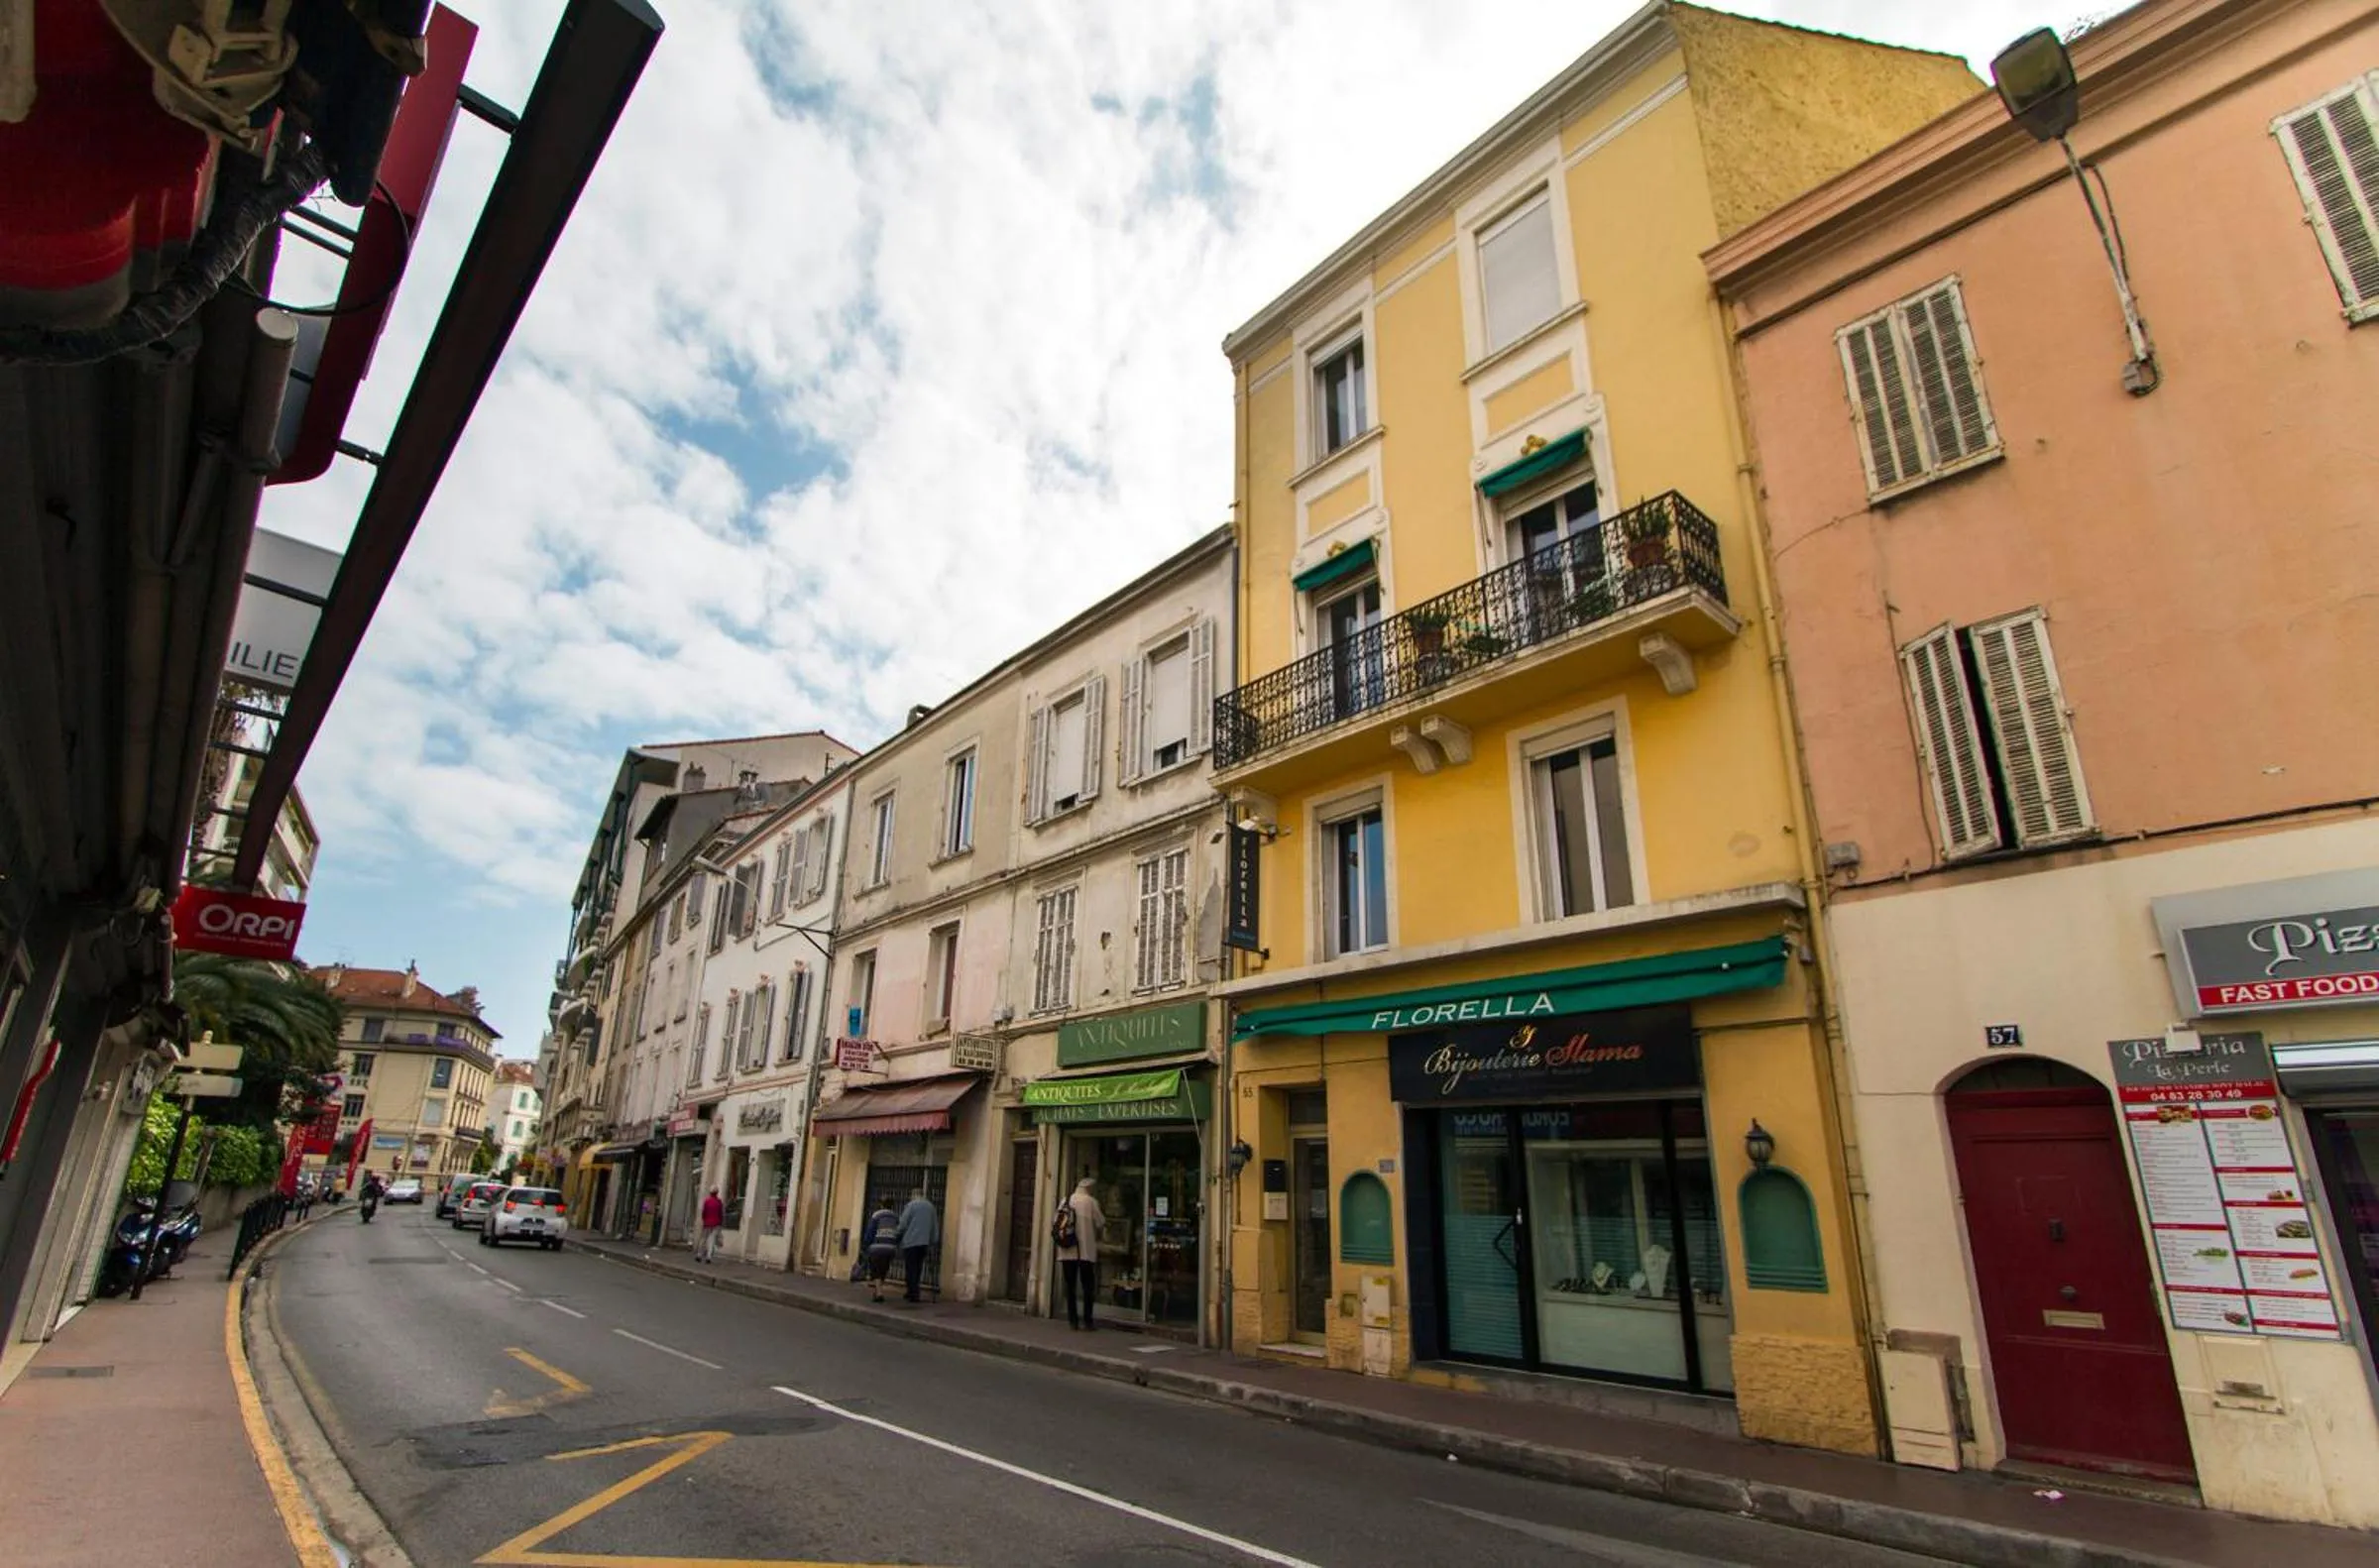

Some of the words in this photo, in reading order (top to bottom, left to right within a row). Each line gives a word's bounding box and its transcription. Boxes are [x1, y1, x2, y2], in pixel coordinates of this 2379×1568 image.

[198, 903, 296, 941] ORPI
[2247, 917, 2379, 976] Piz
[2219, 982, 2288, 1004] FAST
[2295, 974, 2379, 997] FOOD
[1371, 992, 1555, 1030] FLORELLA
[1990, 1027, 2015, 1045] 57
[2121, 1036, 2246, 1069] Piria
[1423, 1044, 1542, 1095] Bijouterie
[2176, 1060, 2230, 1080] Perle
